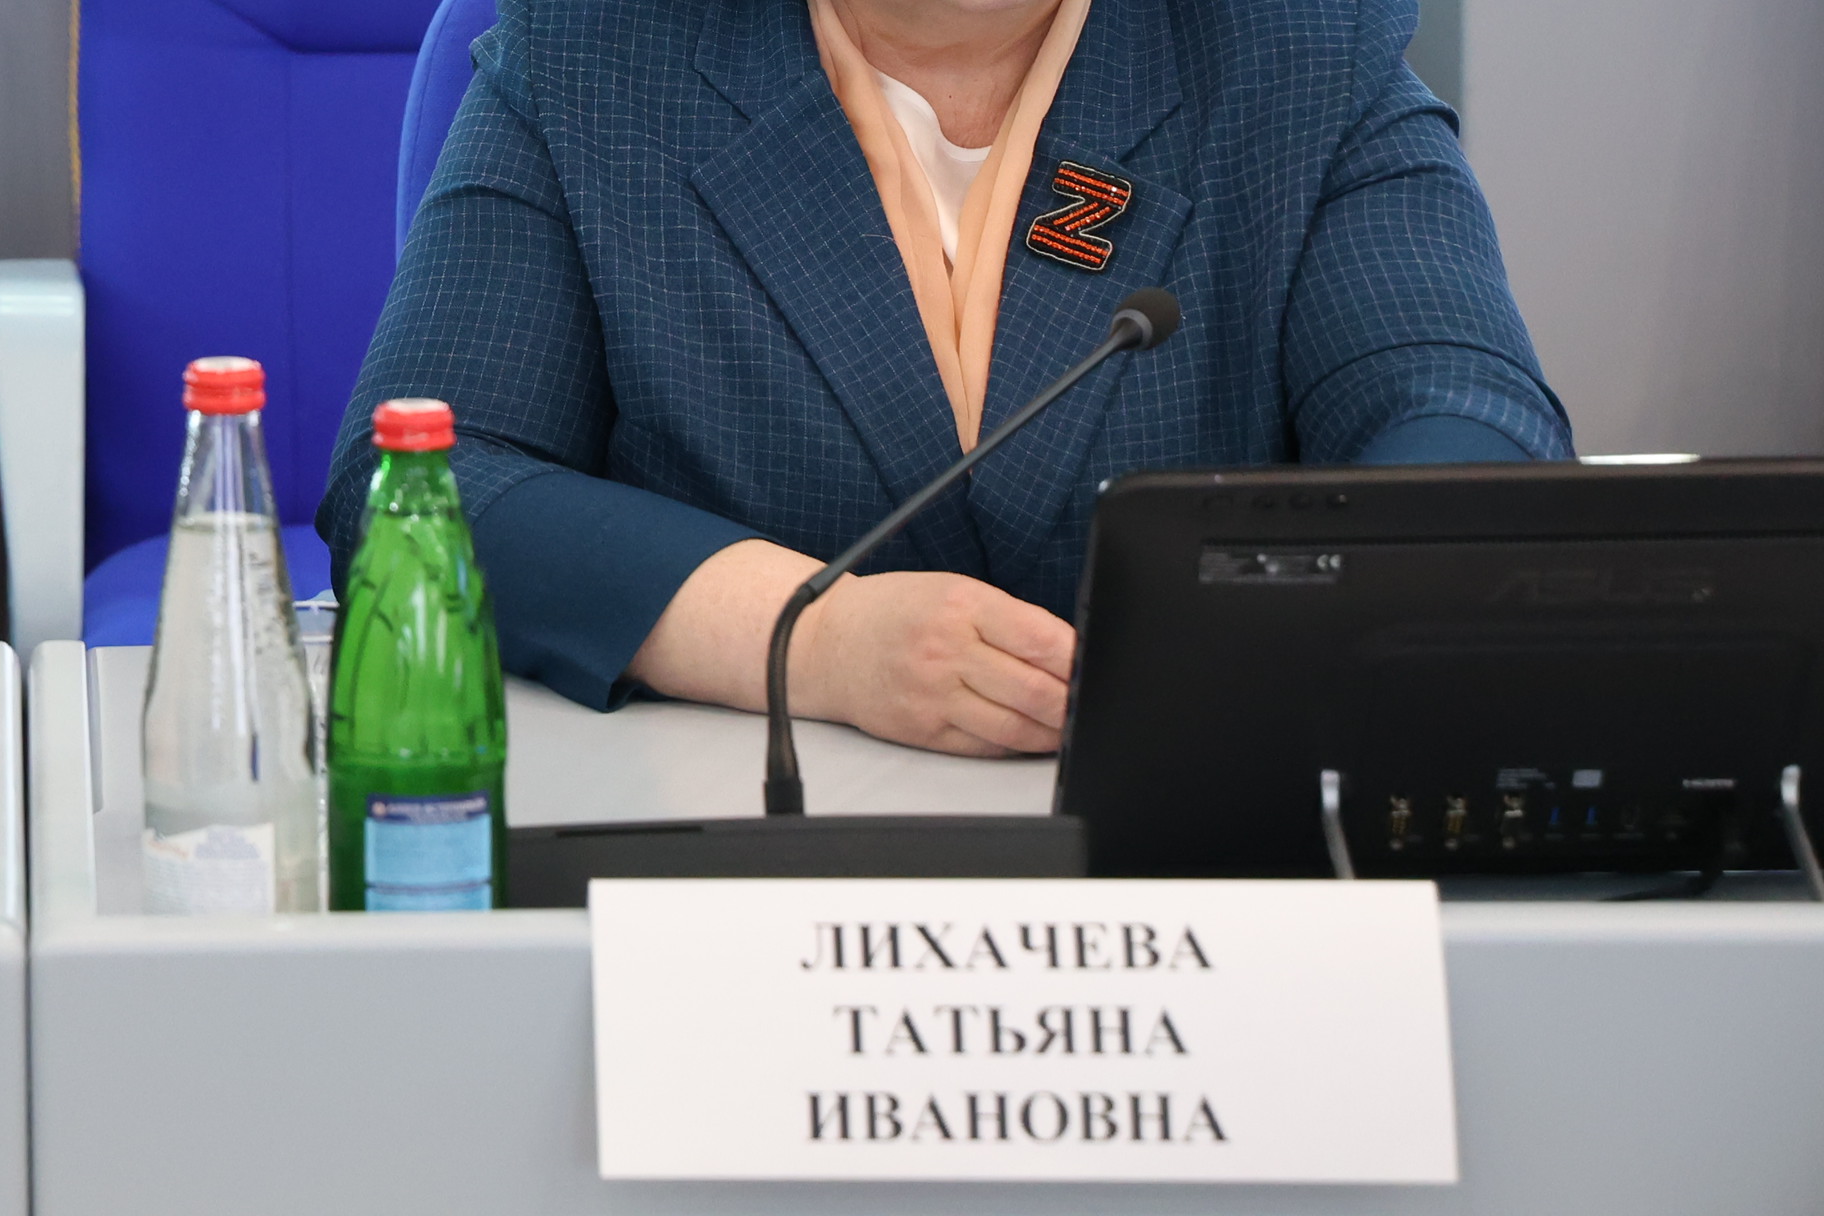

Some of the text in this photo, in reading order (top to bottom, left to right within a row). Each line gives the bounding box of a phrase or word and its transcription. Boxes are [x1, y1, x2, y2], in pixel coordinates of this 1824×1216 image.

[800, 923, 1213, 971] ЛИХАЧЕВА
[833, 1005, 1190, 1057] ТАТЬЯНА
[806, 1091, 1230, 1144] ИВАНОВНА
